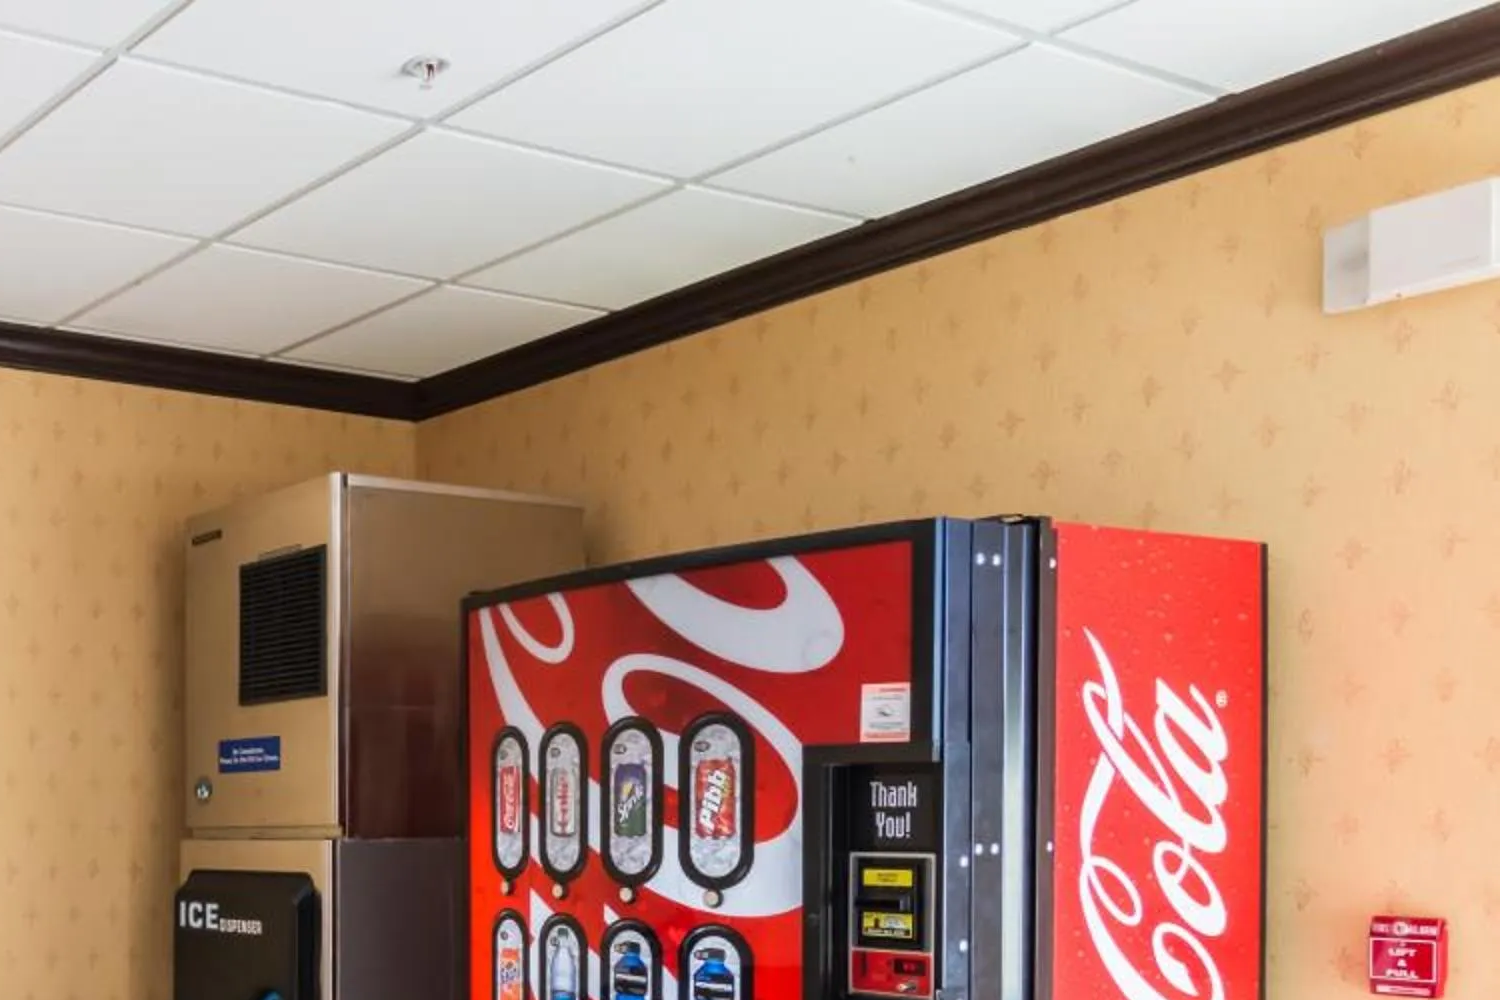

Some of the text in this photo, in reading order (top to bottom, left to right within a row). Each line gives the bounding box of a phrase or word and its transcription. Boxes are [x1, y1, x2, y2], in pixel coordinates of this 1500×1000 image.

[869, 780, 918, 808] Thank
[875, 811, 912, 838] You!
[178, 900, 263, 935] ICE DISPENSER
